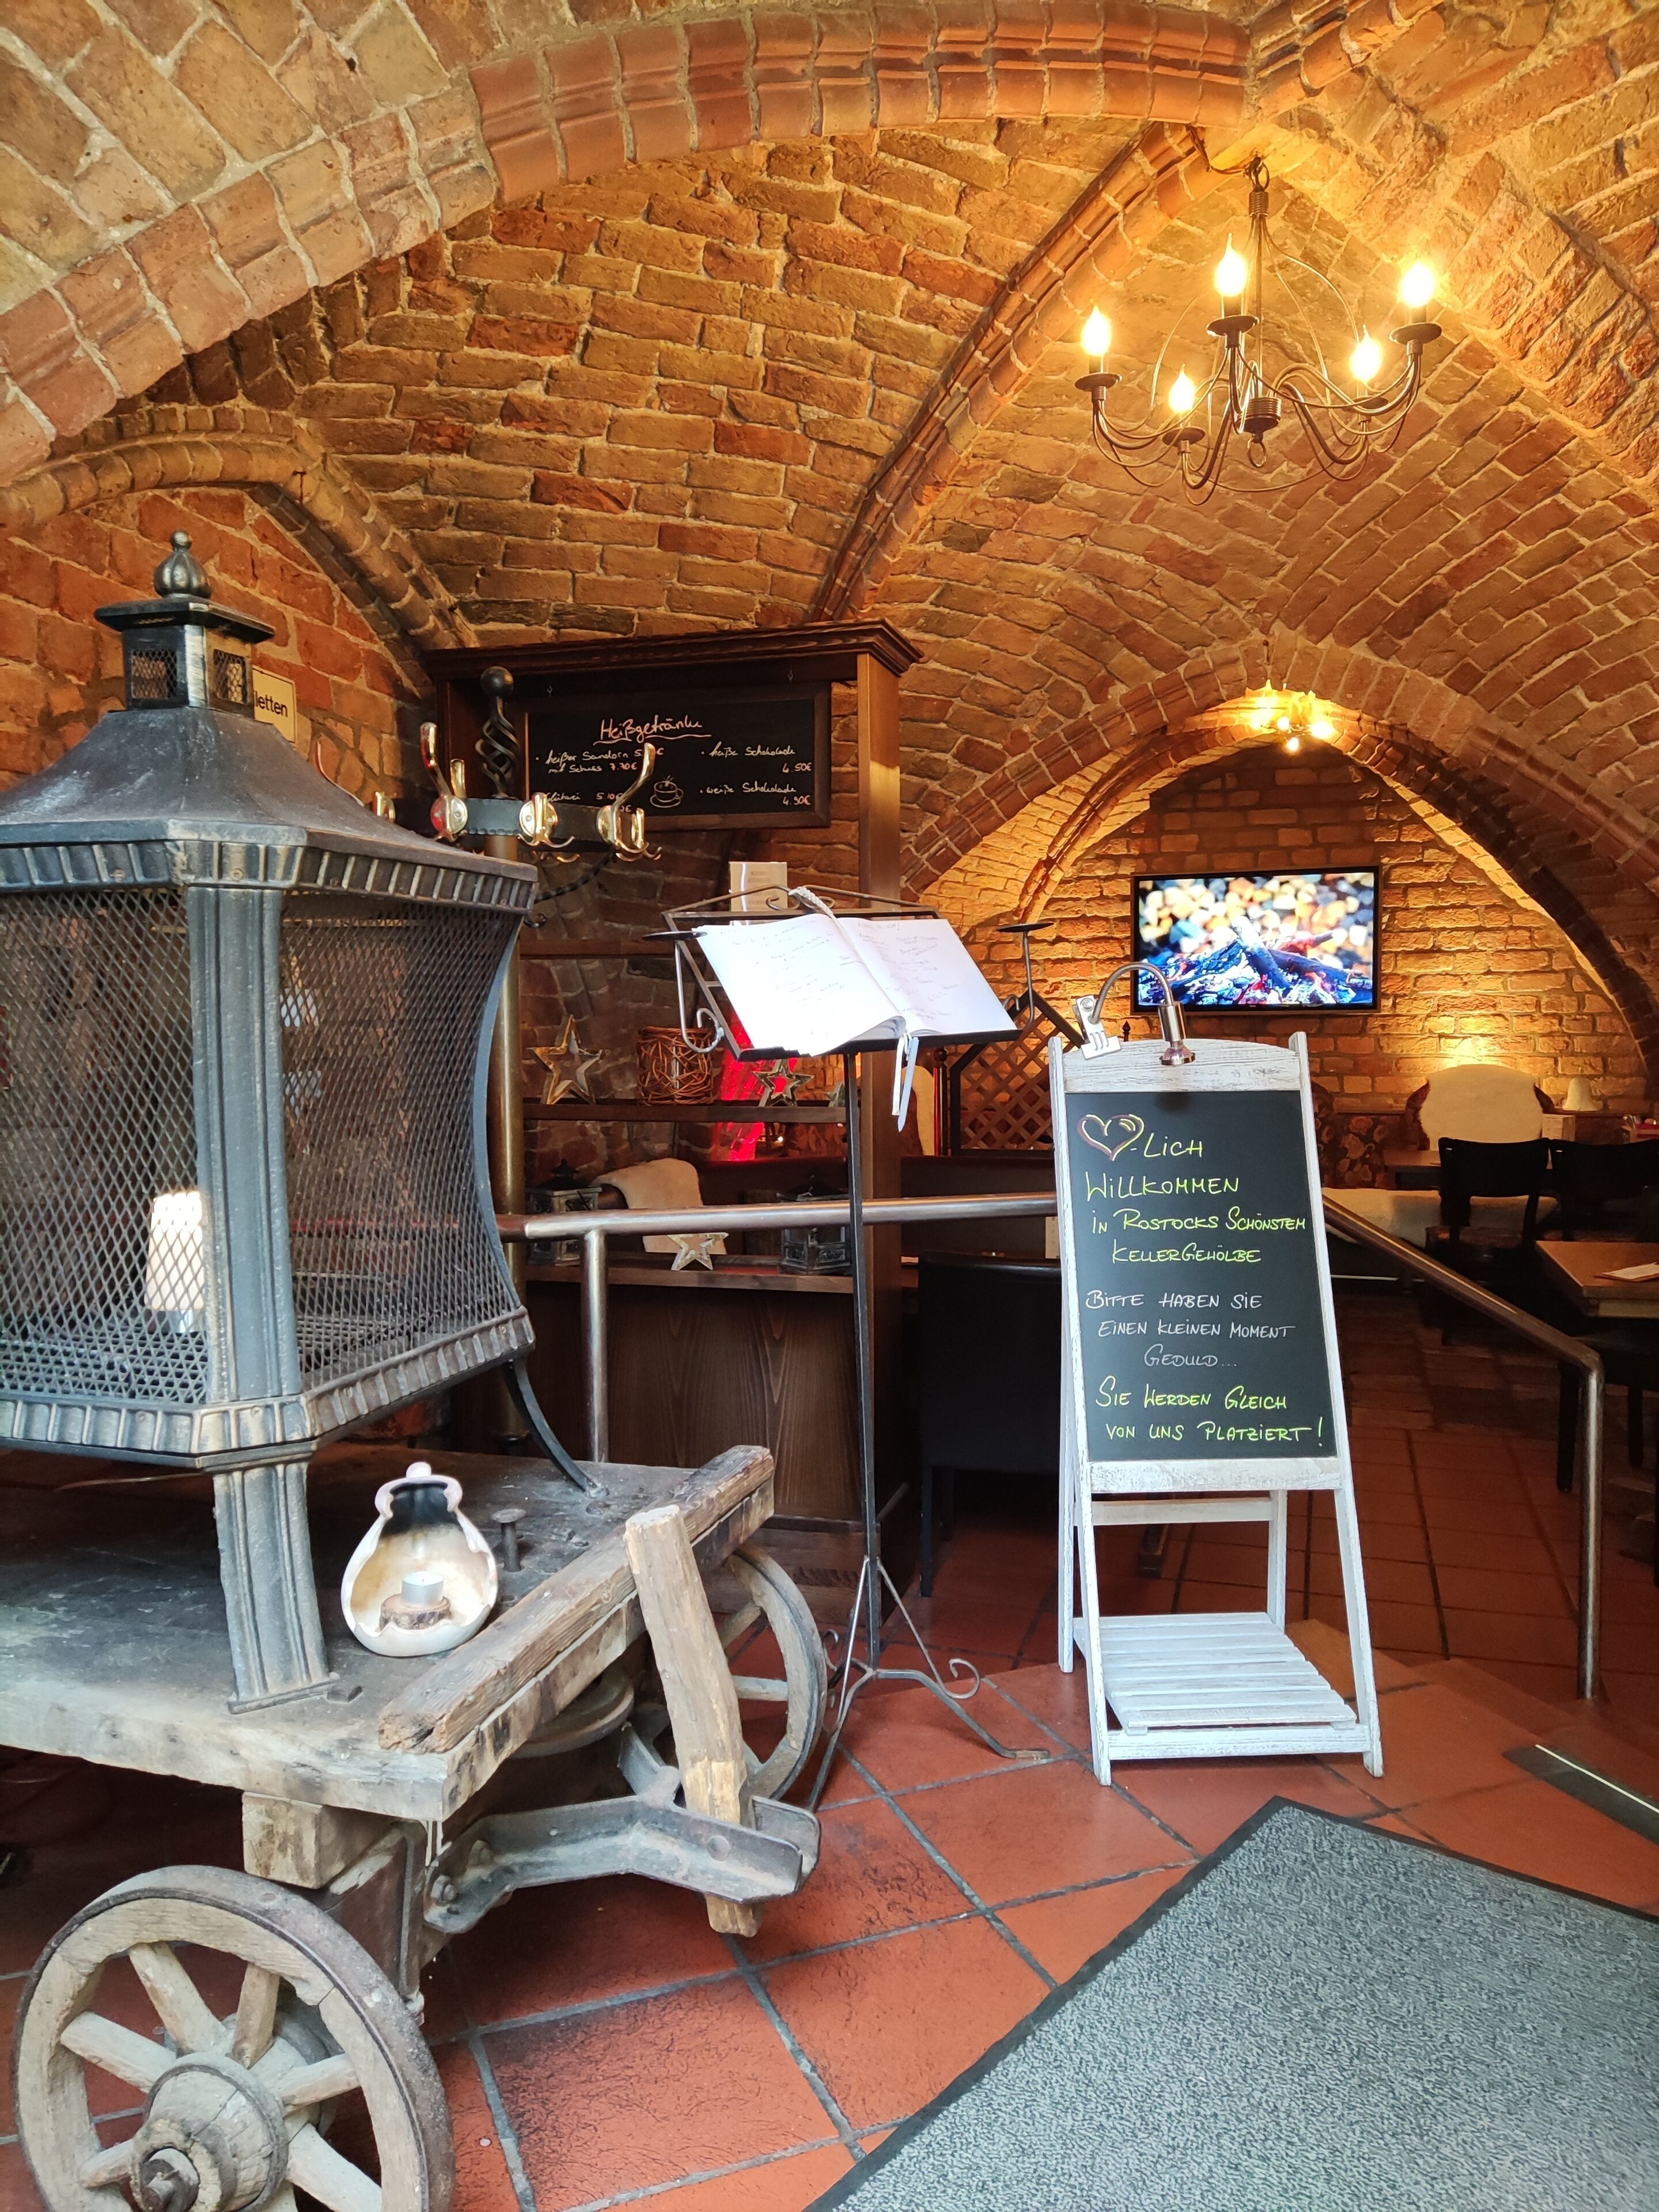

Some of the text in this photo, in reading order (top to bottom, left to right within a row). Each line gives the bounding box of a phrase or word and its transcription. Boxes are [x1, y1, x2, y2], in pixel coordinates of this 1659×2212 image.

[255, 691, 288, 718] letten
[548, 763, 566, 774] mit
[706, 784, 734, 795] weiße
[1158, 1292, 1219, 1309] HABEN
[1229, 1321, 1296, 1339] MOMENT
[1105, 1423, 1135, 1441] VON
[1149, 1423, 1184, 1441] UNS
